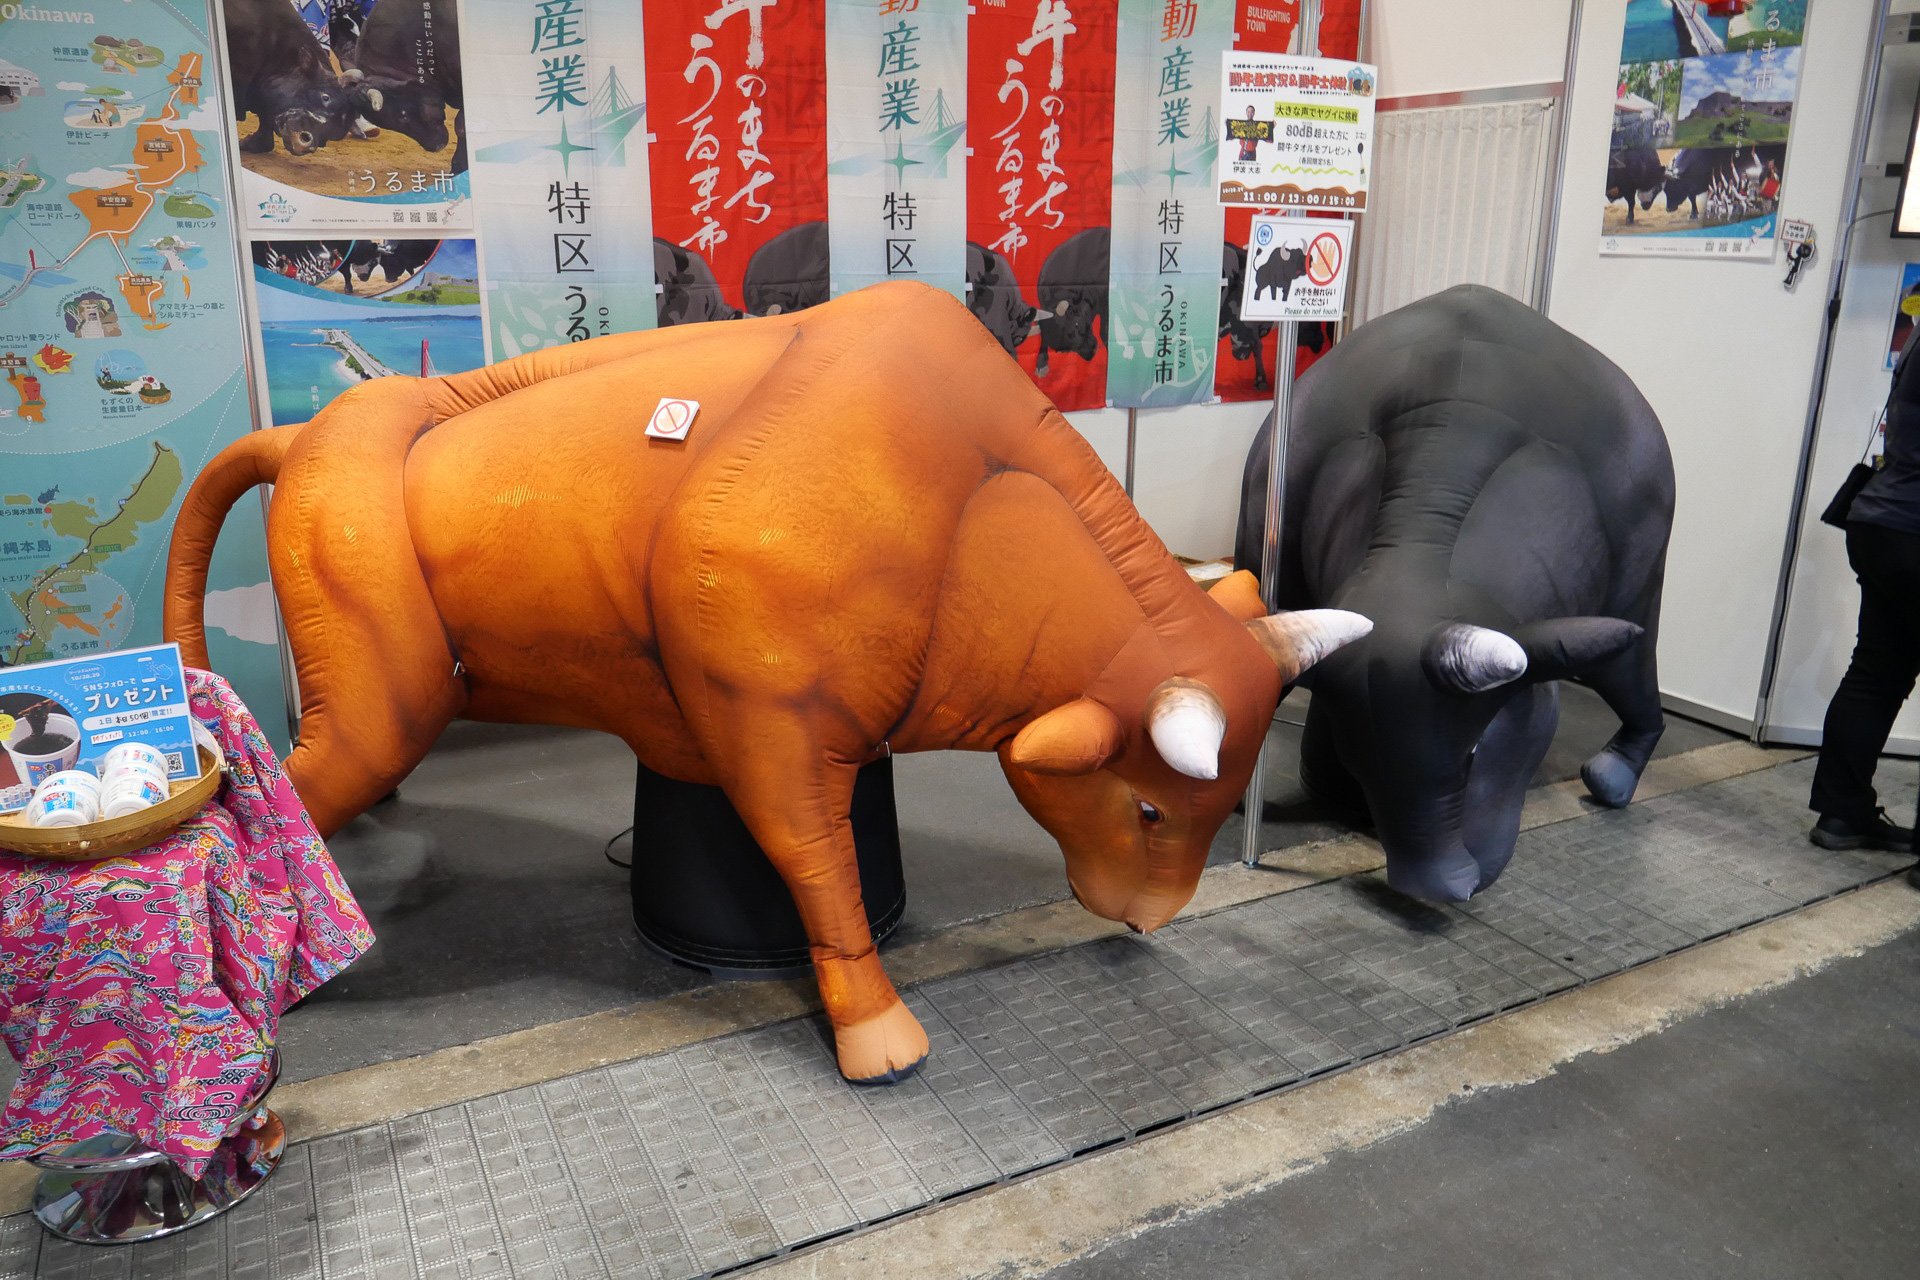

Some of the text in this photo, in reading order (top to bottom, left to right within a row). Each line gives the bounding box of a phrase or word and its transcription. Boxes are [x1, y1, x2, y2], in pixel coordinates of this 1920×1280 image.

[1, 4, 95, 25] Okinawa
[1246, 19, 1266, 33] TOWN
[1247, 6, 1291, 24] BULLFIGHTING
[423, 2, 435, 75] 感動はいつだって
[416, 39, 425, 84] ここにある
[531, 0, 589, 115] 産業
[1017, 0, 1076, 229] 牛のまち
[66, 131, 110, 140] 伊計ビーチ
[677, 33, 729, 263] うるま市
[1277, 142, 1352, 156] 闘牛タオルをプレゼント
[988, 58, 1029, 265] うるま市
[360, 169, 455, 194] うるま市
[1154, 0, 1197, 384] 動産業 特区 うるま市
[28, 212, 80, 220] ロードパーク
[547, 181, 595, 274] 特区
[882, 192, 918, 274] 特区
[158, 303, 225, 312] アマミチューの墓と
[1301, 298, 1328, 306] でください
[1178, 301, 1188, 369] OKINAWA
[101, 397, 133, 405] もずくの
[0, 540, 51, 555] 縄本島
[61, 641, 99, 651] うるま市
[83, 677, 136, 692] SNSフォローで
[85, 684, 174, 712] プレゼント
